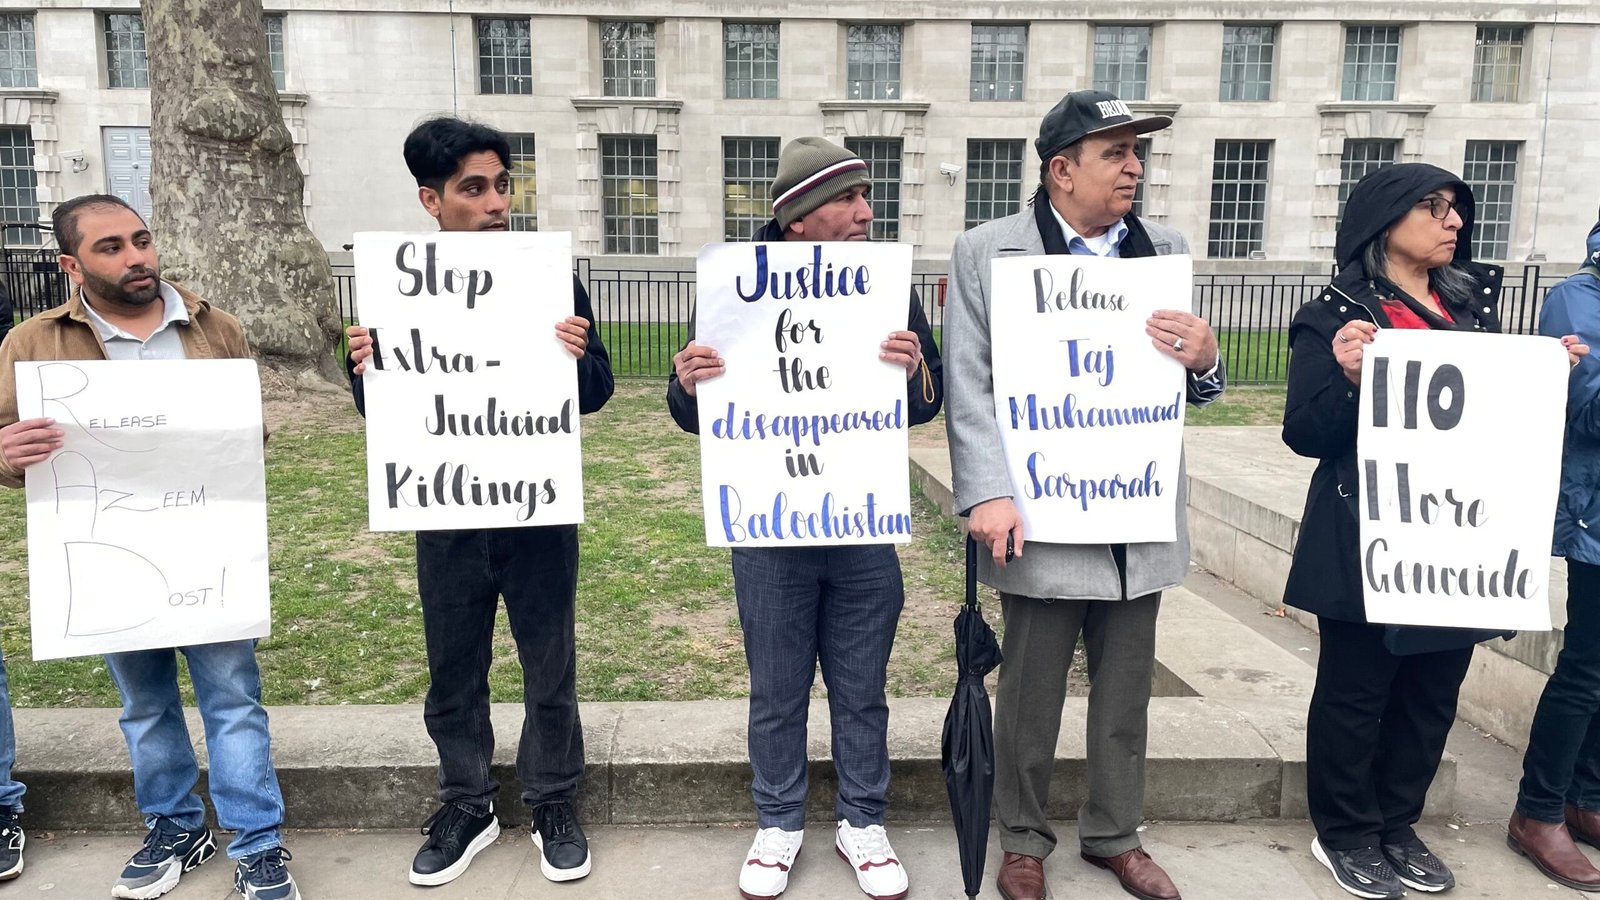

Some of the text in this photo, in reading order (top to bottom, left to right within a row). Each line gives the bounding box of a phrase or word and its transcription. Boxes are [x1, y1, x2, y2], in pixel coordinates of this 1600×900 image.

[395, 241, 493, 309] Stop
[736, 245, 871, 302] Justice
[1033, 267, 1129, 313] Release
[775, 308, 824, 353] for
[772, 357, 832, 393] the
[1059, 338, 1115, 386] Taj
[425, 394, 577, 436] Judicial
[712, 399, 905, 447] disappeared
[1008, 391, 1181, 431] Muhammad
[785, 448, 824, 478] in
[1024, 452, 1163, 511] Sarparah
[385, 461, 557, 522] Killings
[719, 484, 912, 543] Balochistan
[1364, 459, 1489, 528] More
[1366, 538, 1540, 600] Genocide
